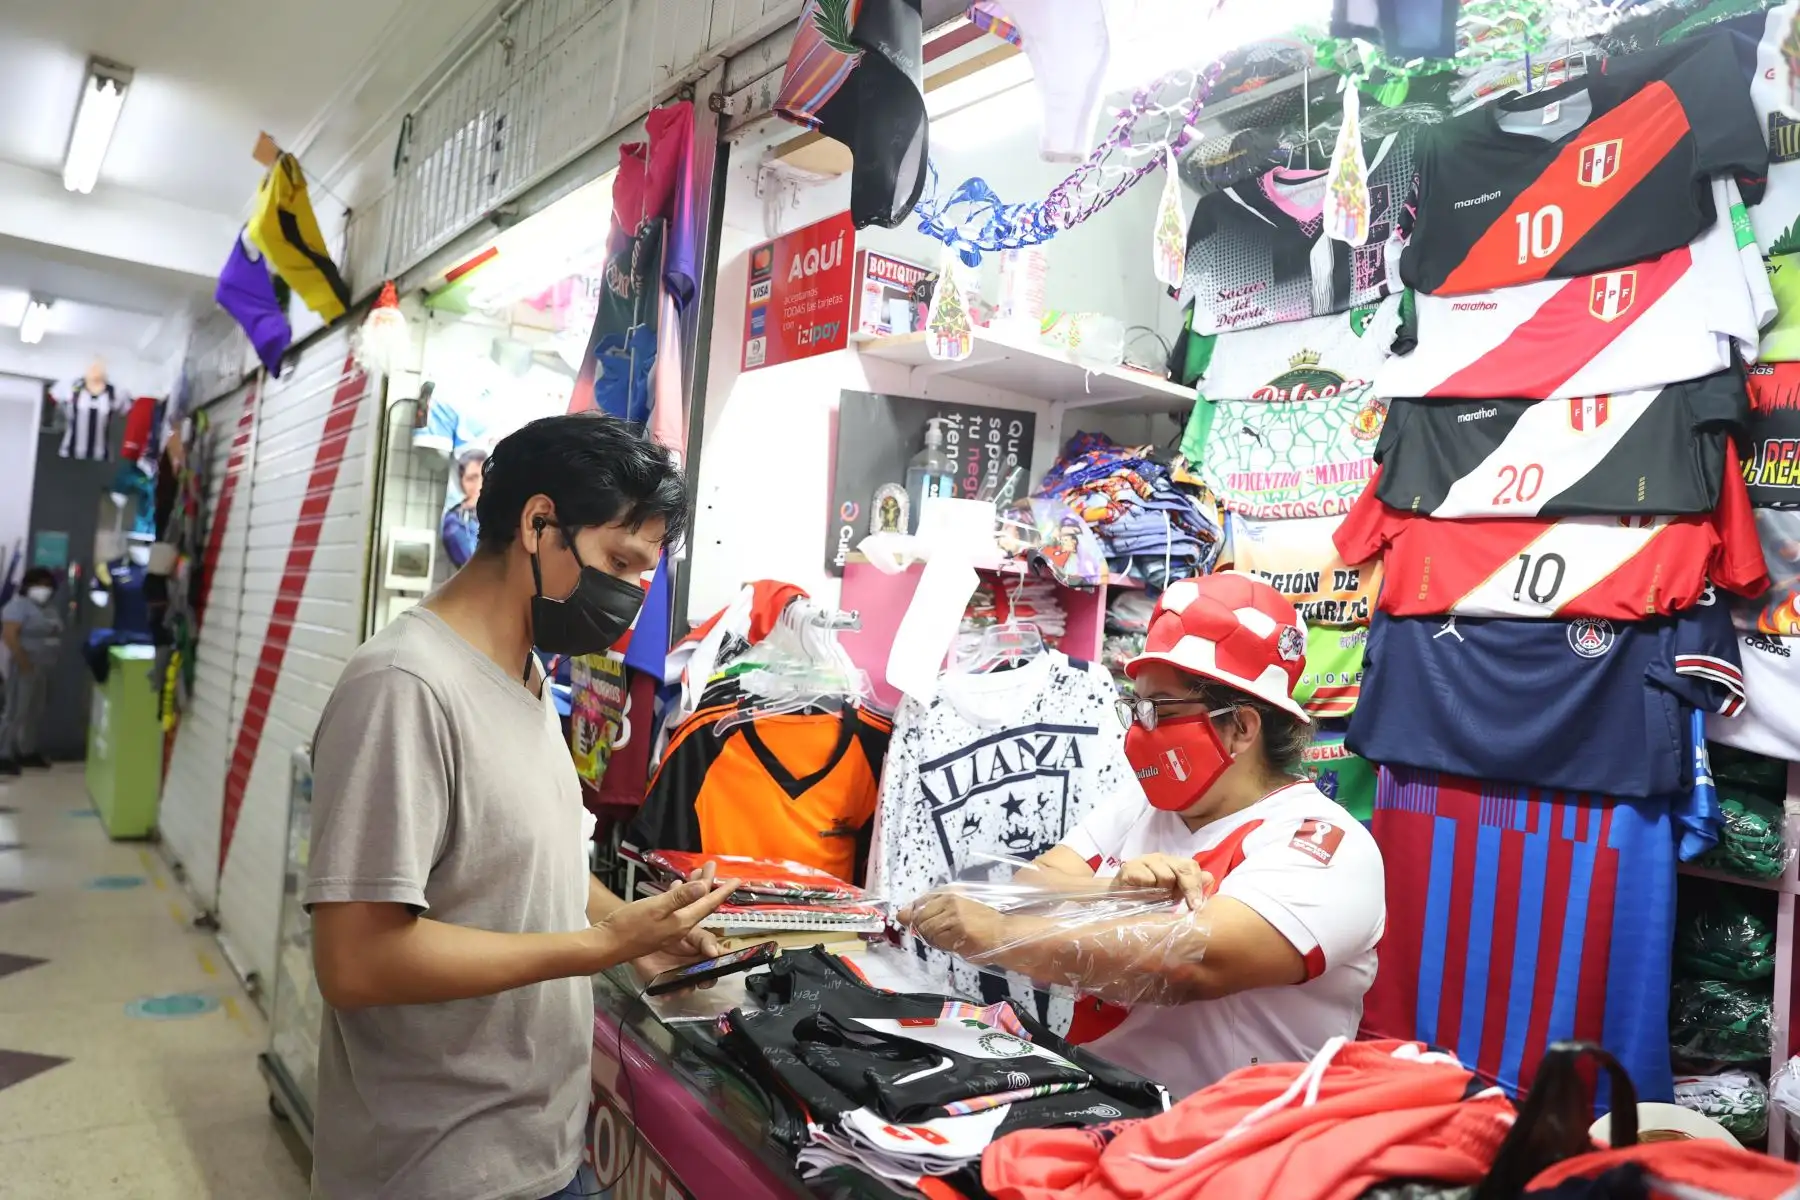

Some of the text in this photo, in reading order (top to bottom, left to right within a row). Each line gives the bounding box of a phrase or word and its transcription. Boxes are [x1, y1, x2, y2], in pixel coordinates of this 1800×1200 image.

[1584, 154, 1615, 170] FPF
[1454, 189, 1501, 210] marathon
[1515, 203, 1564, 265] 10
[787, 229, 846, 284] AQUÍ
[752, 285, 769, 299] VISA
[817, 294, 844, 311] tarjetas
[1594, 287, 1631, 301] FPF
[1451, 299, 1498, 312] marathon
[797, 320, 841, 347] izipay
[1457, 406, 1498, 424] marathon
[1573, 402, 1606, 417] FPF
[968, 415, 983, 439] tu
[985, 417, 1001, 489] sepan
[1006, 420, 1023, 467] Que
[1491, 463, 1545, 506] 20
[833, 525, 854, 567] Culqi
[1333, 569, 1360, 592] DE
[1513, 552, 1566, 604] 10
[1576, 617, 1607, 628] PARIS
[1745, 636, 1791, 658] adidas
